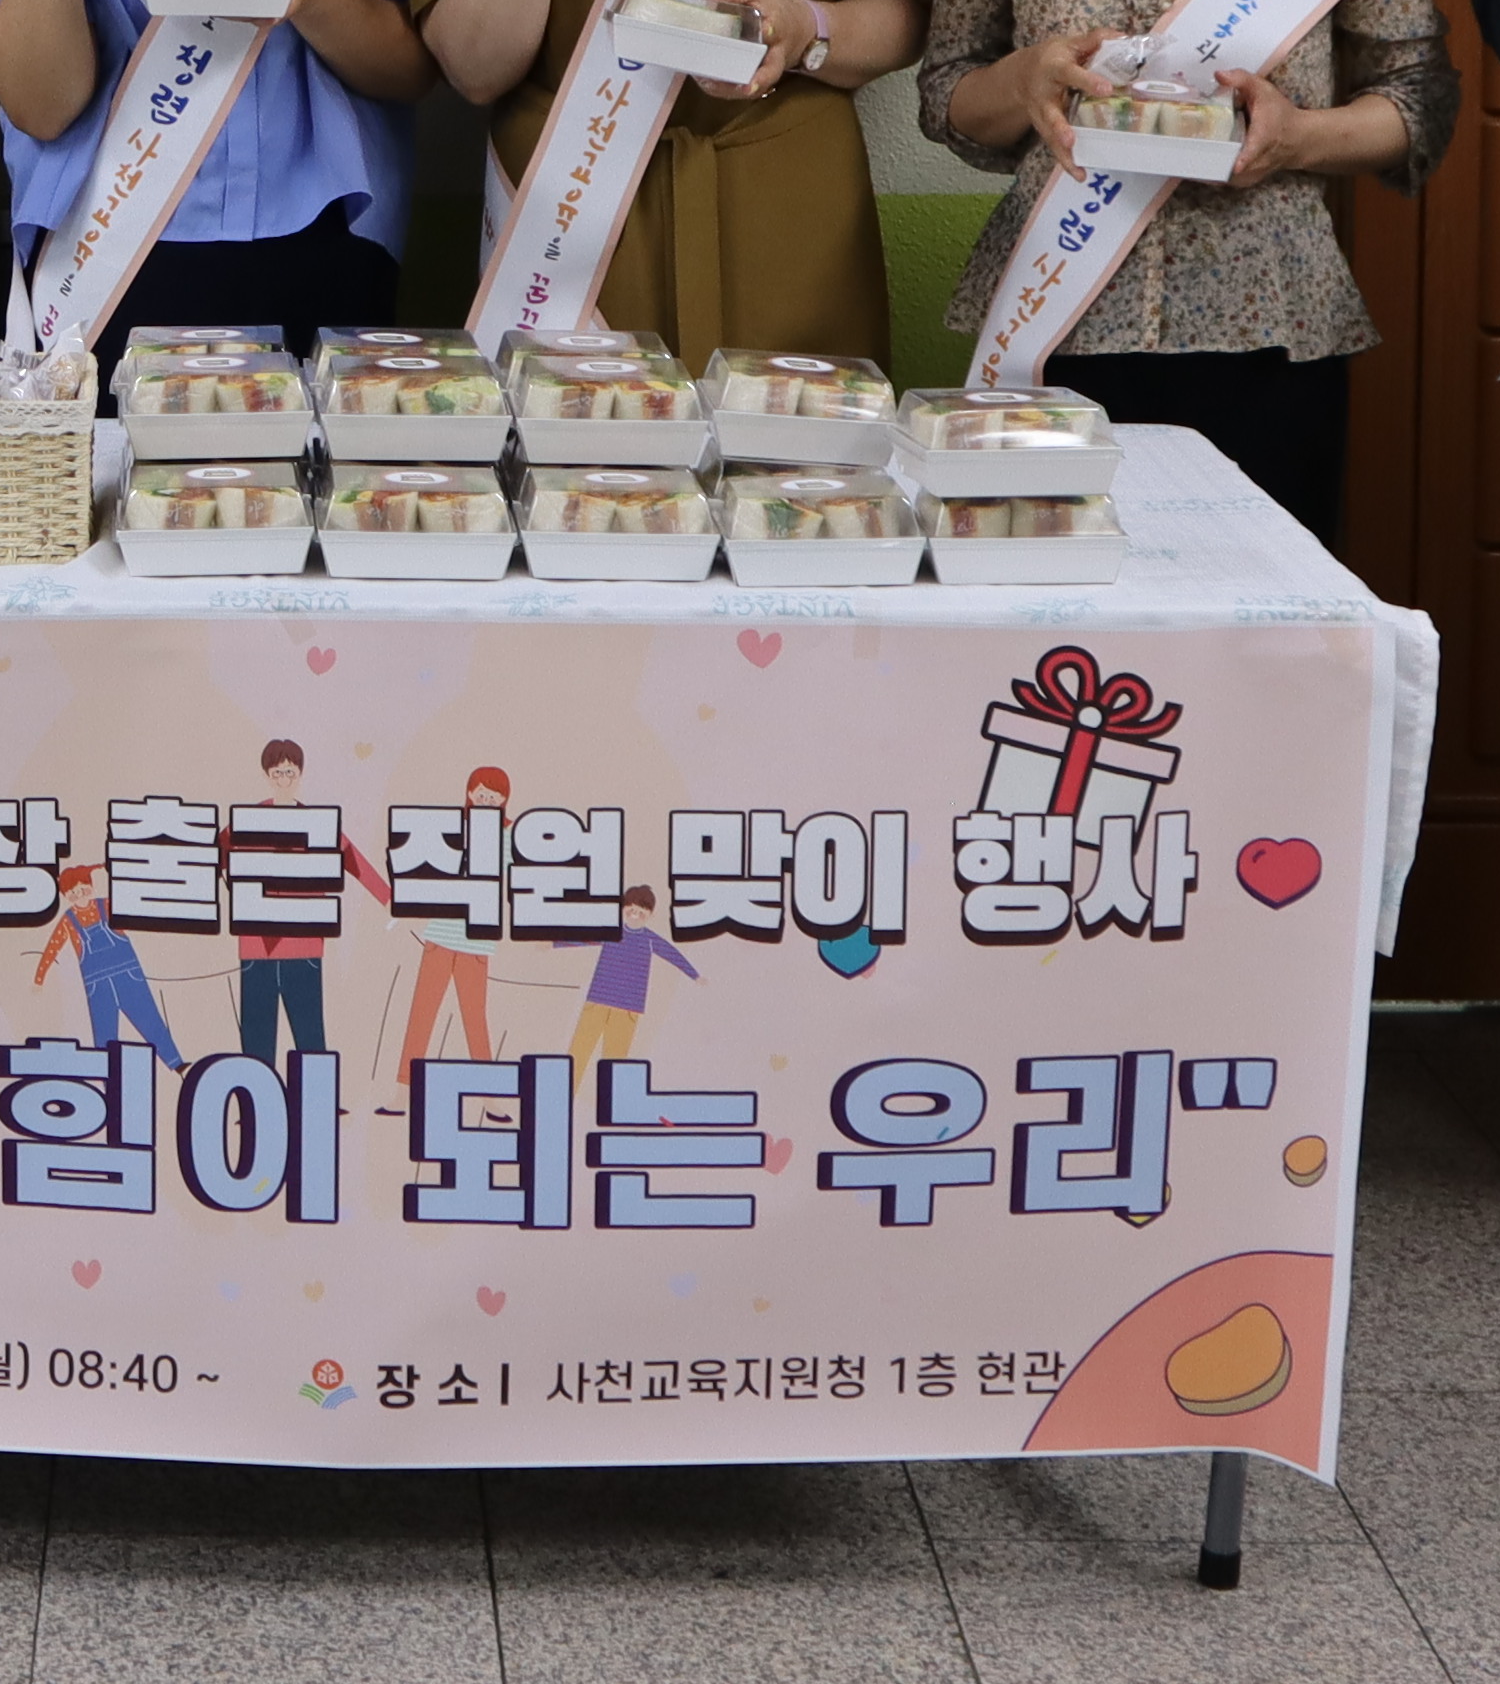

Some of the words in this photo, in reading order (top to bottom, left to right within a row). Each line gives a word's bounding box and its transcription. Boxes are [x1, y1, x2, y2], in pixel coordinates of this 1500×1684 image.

[150, 44, 213, 125] 청렴
[58, 131, 160, 298] 사천교육을
[544, 78, 634, 261] 사천교육을
[1058, 173, 1123, 253] 청렴
[981, 252, 1067, 388] 사천교육
[104, 795, 343, 936] 출근
[386, 805, 625, 942] 직원
[668, 807, 909, 944] 맞이
[952, 809, 1199, 946] 행사
[402, 1053, 767, 1232] 되는
[48, 1345, 180, 1393] 08:40
[544, 1352, 868, 1404] 사천교육지원청
[889, 1352, 959, 1398] 1층
[977, 1349, 1067, 1397] 현관
